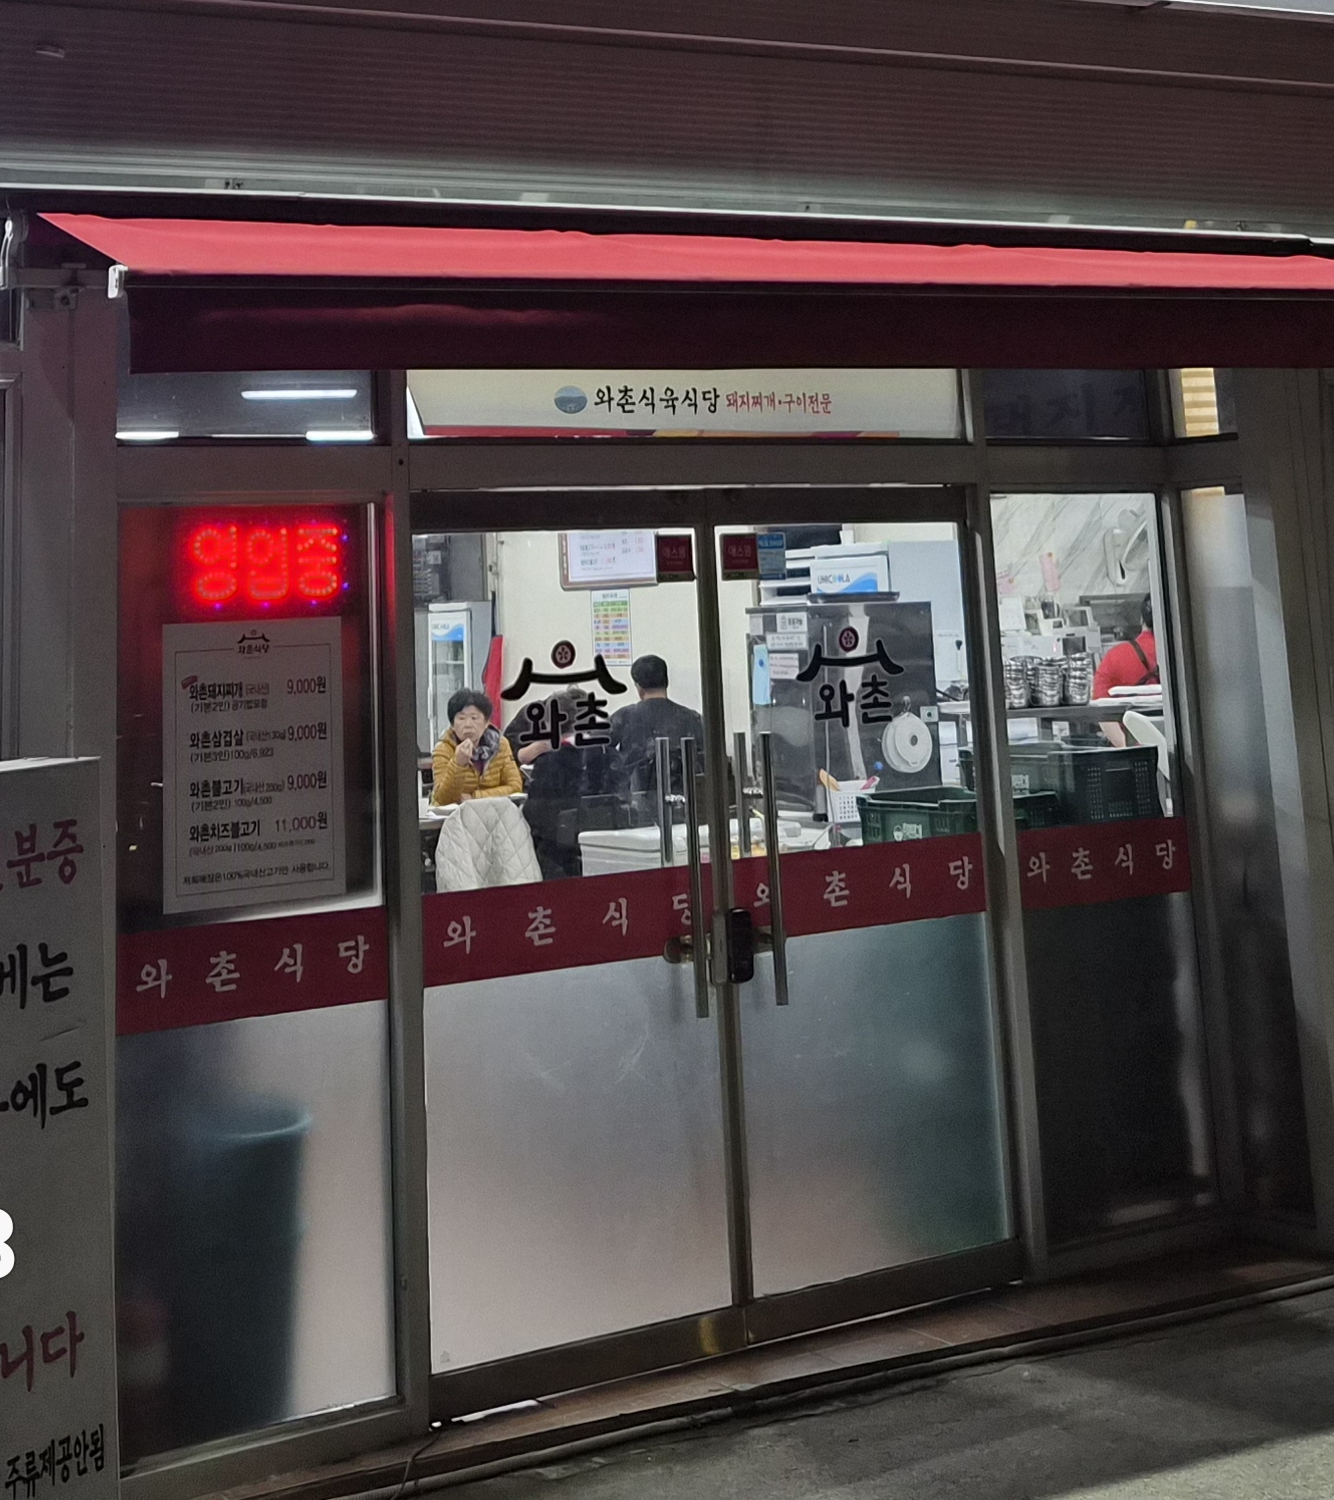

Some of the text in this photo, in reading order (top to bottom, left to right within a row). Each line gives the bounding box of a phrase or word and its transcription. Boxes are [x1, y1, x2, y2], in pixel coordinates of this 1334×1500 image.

[593, 385, 720, 415] 와촌식육식당
[191, 522, 339, 601] 영업중
[286, 675, 327, 696] 9,000원
[814, 673, 893, 728] 와촌
[286, 721, 327, 742] 9,000원
[518, 691, 613, 748] 와촌
[286, 771, 327, 791] 9,000원
[275, 811, 328, 833] 11,000원
[1027, 838, 1176, 883] 와촌식당
[135, 934, 369, 1000] 와촌식당
[4, 1423, 105, 1499] 주류제공안됨
